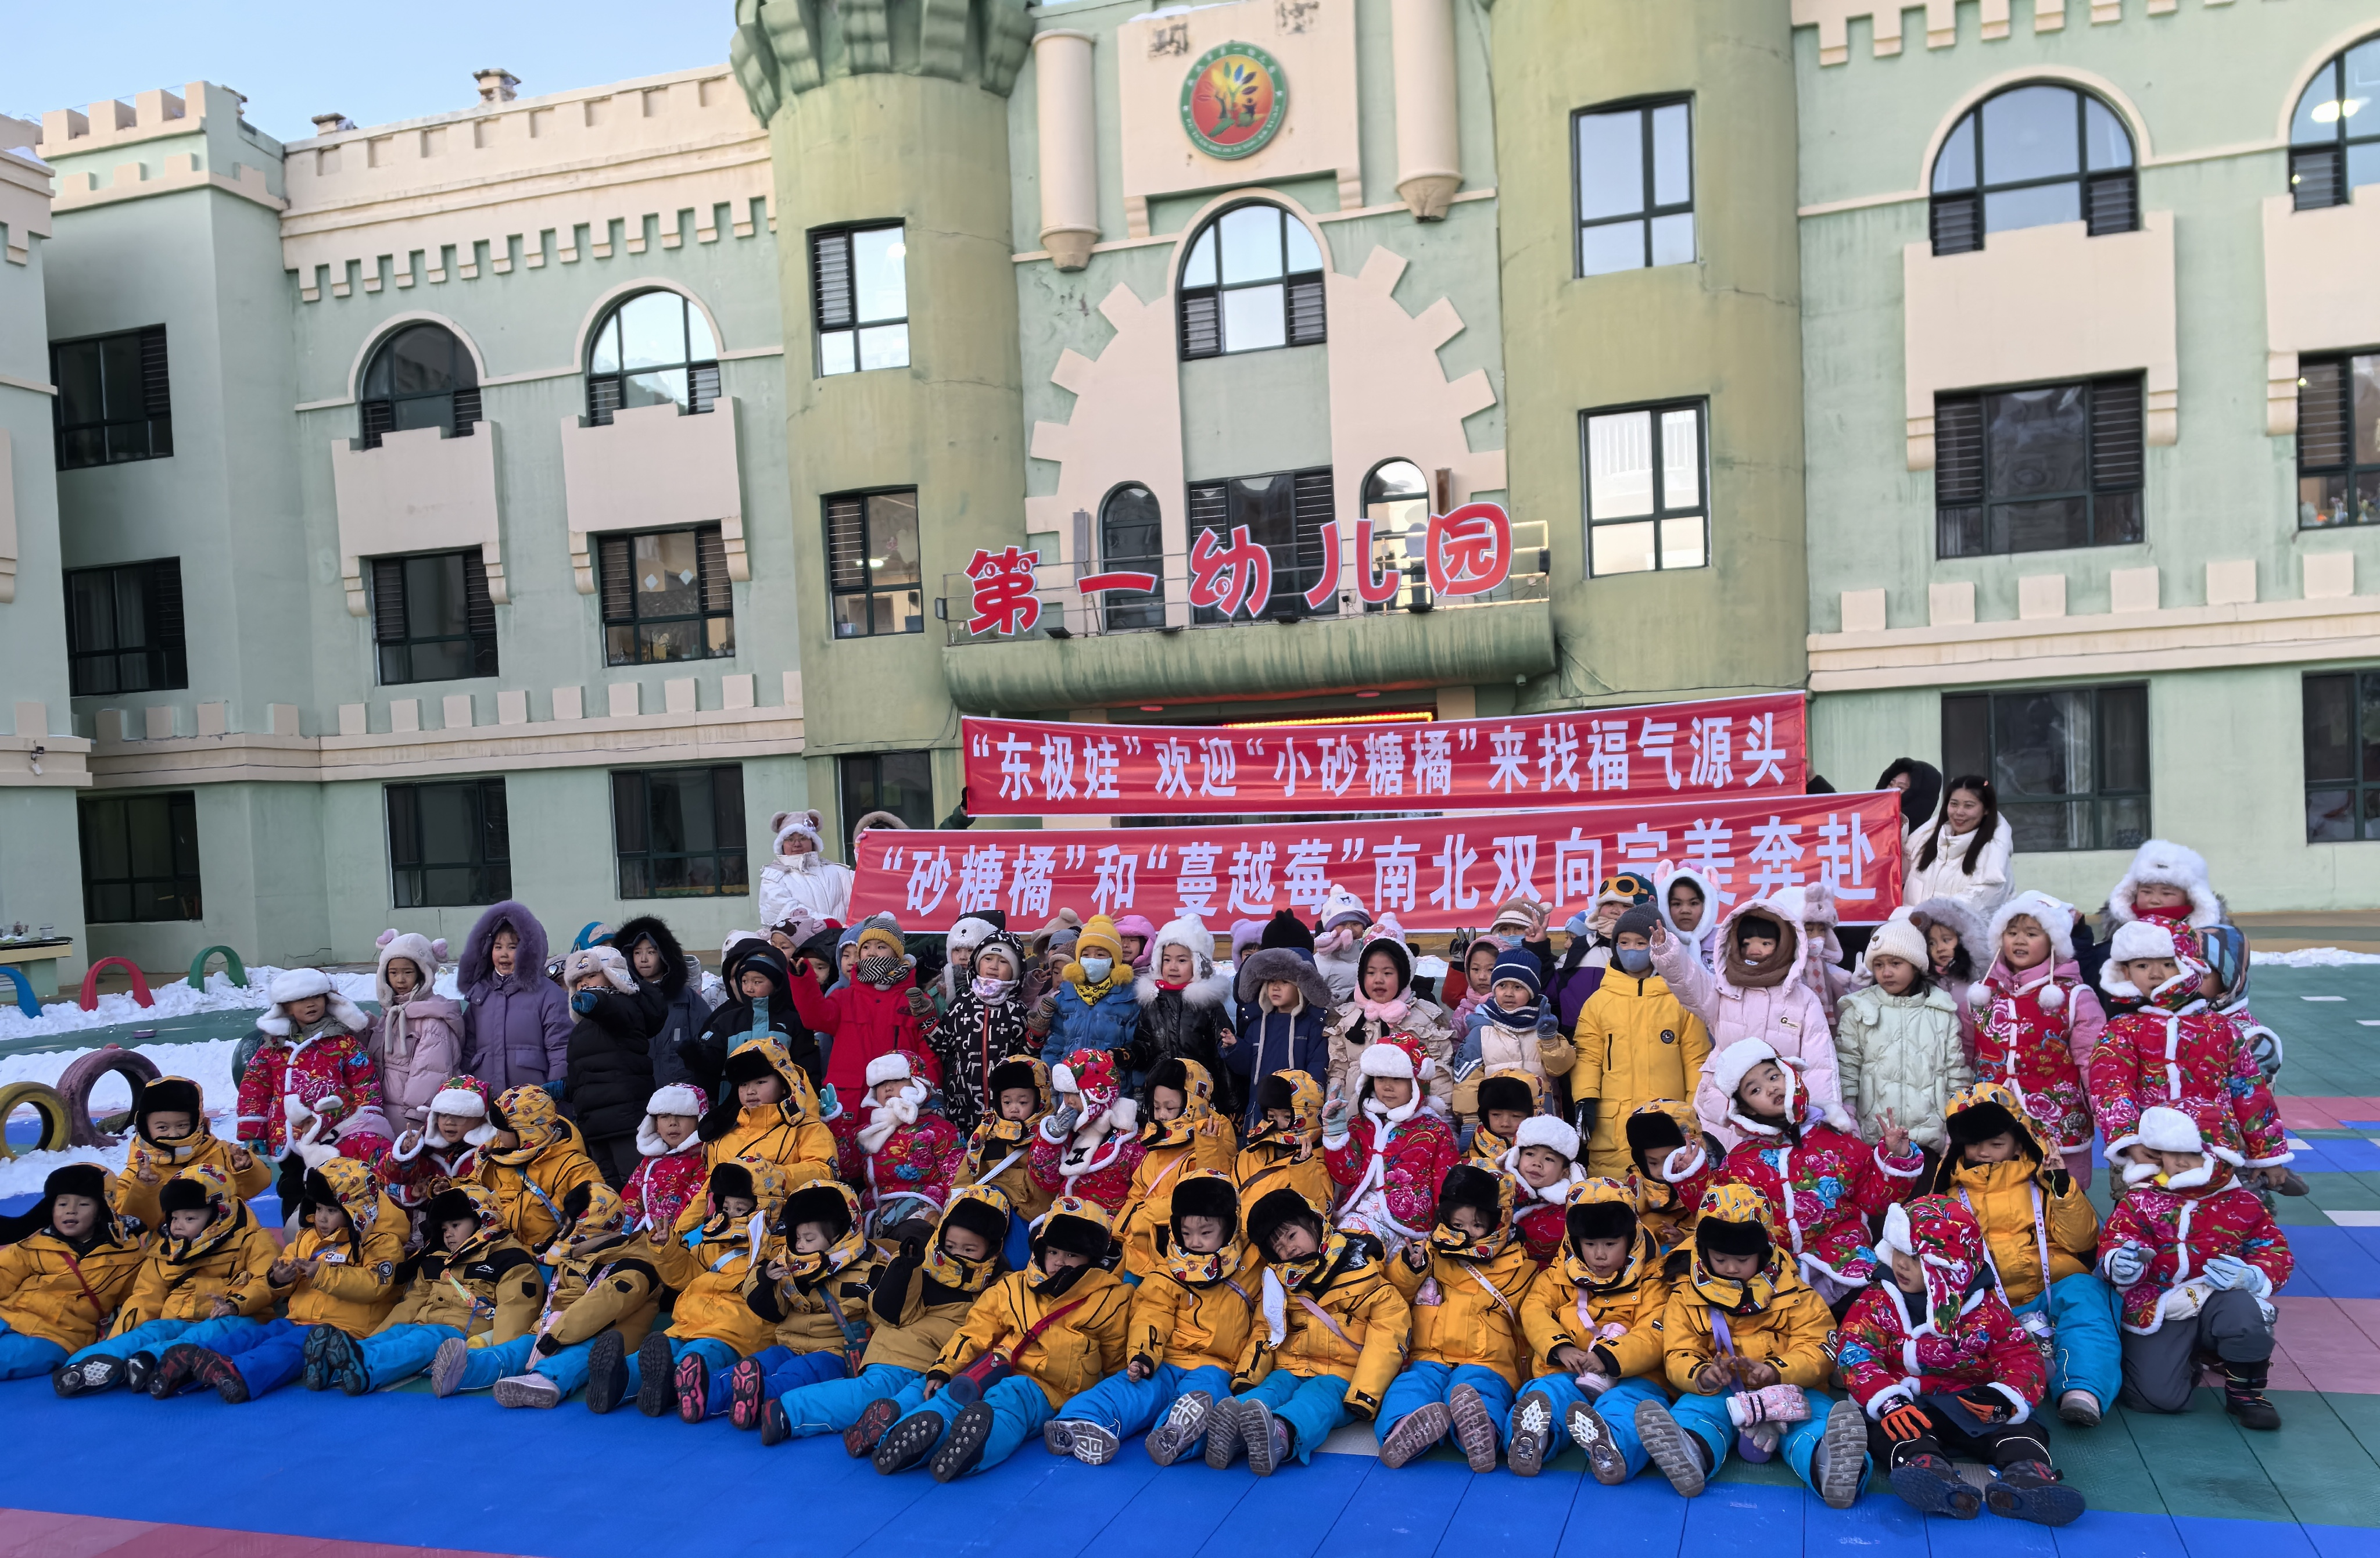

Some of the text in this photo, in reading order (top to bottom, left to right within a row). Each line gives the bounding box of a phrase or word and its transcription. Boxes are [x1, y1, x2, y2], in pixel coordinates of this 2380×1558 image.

[963, 502, 1512, 635] 第一幼儿园
